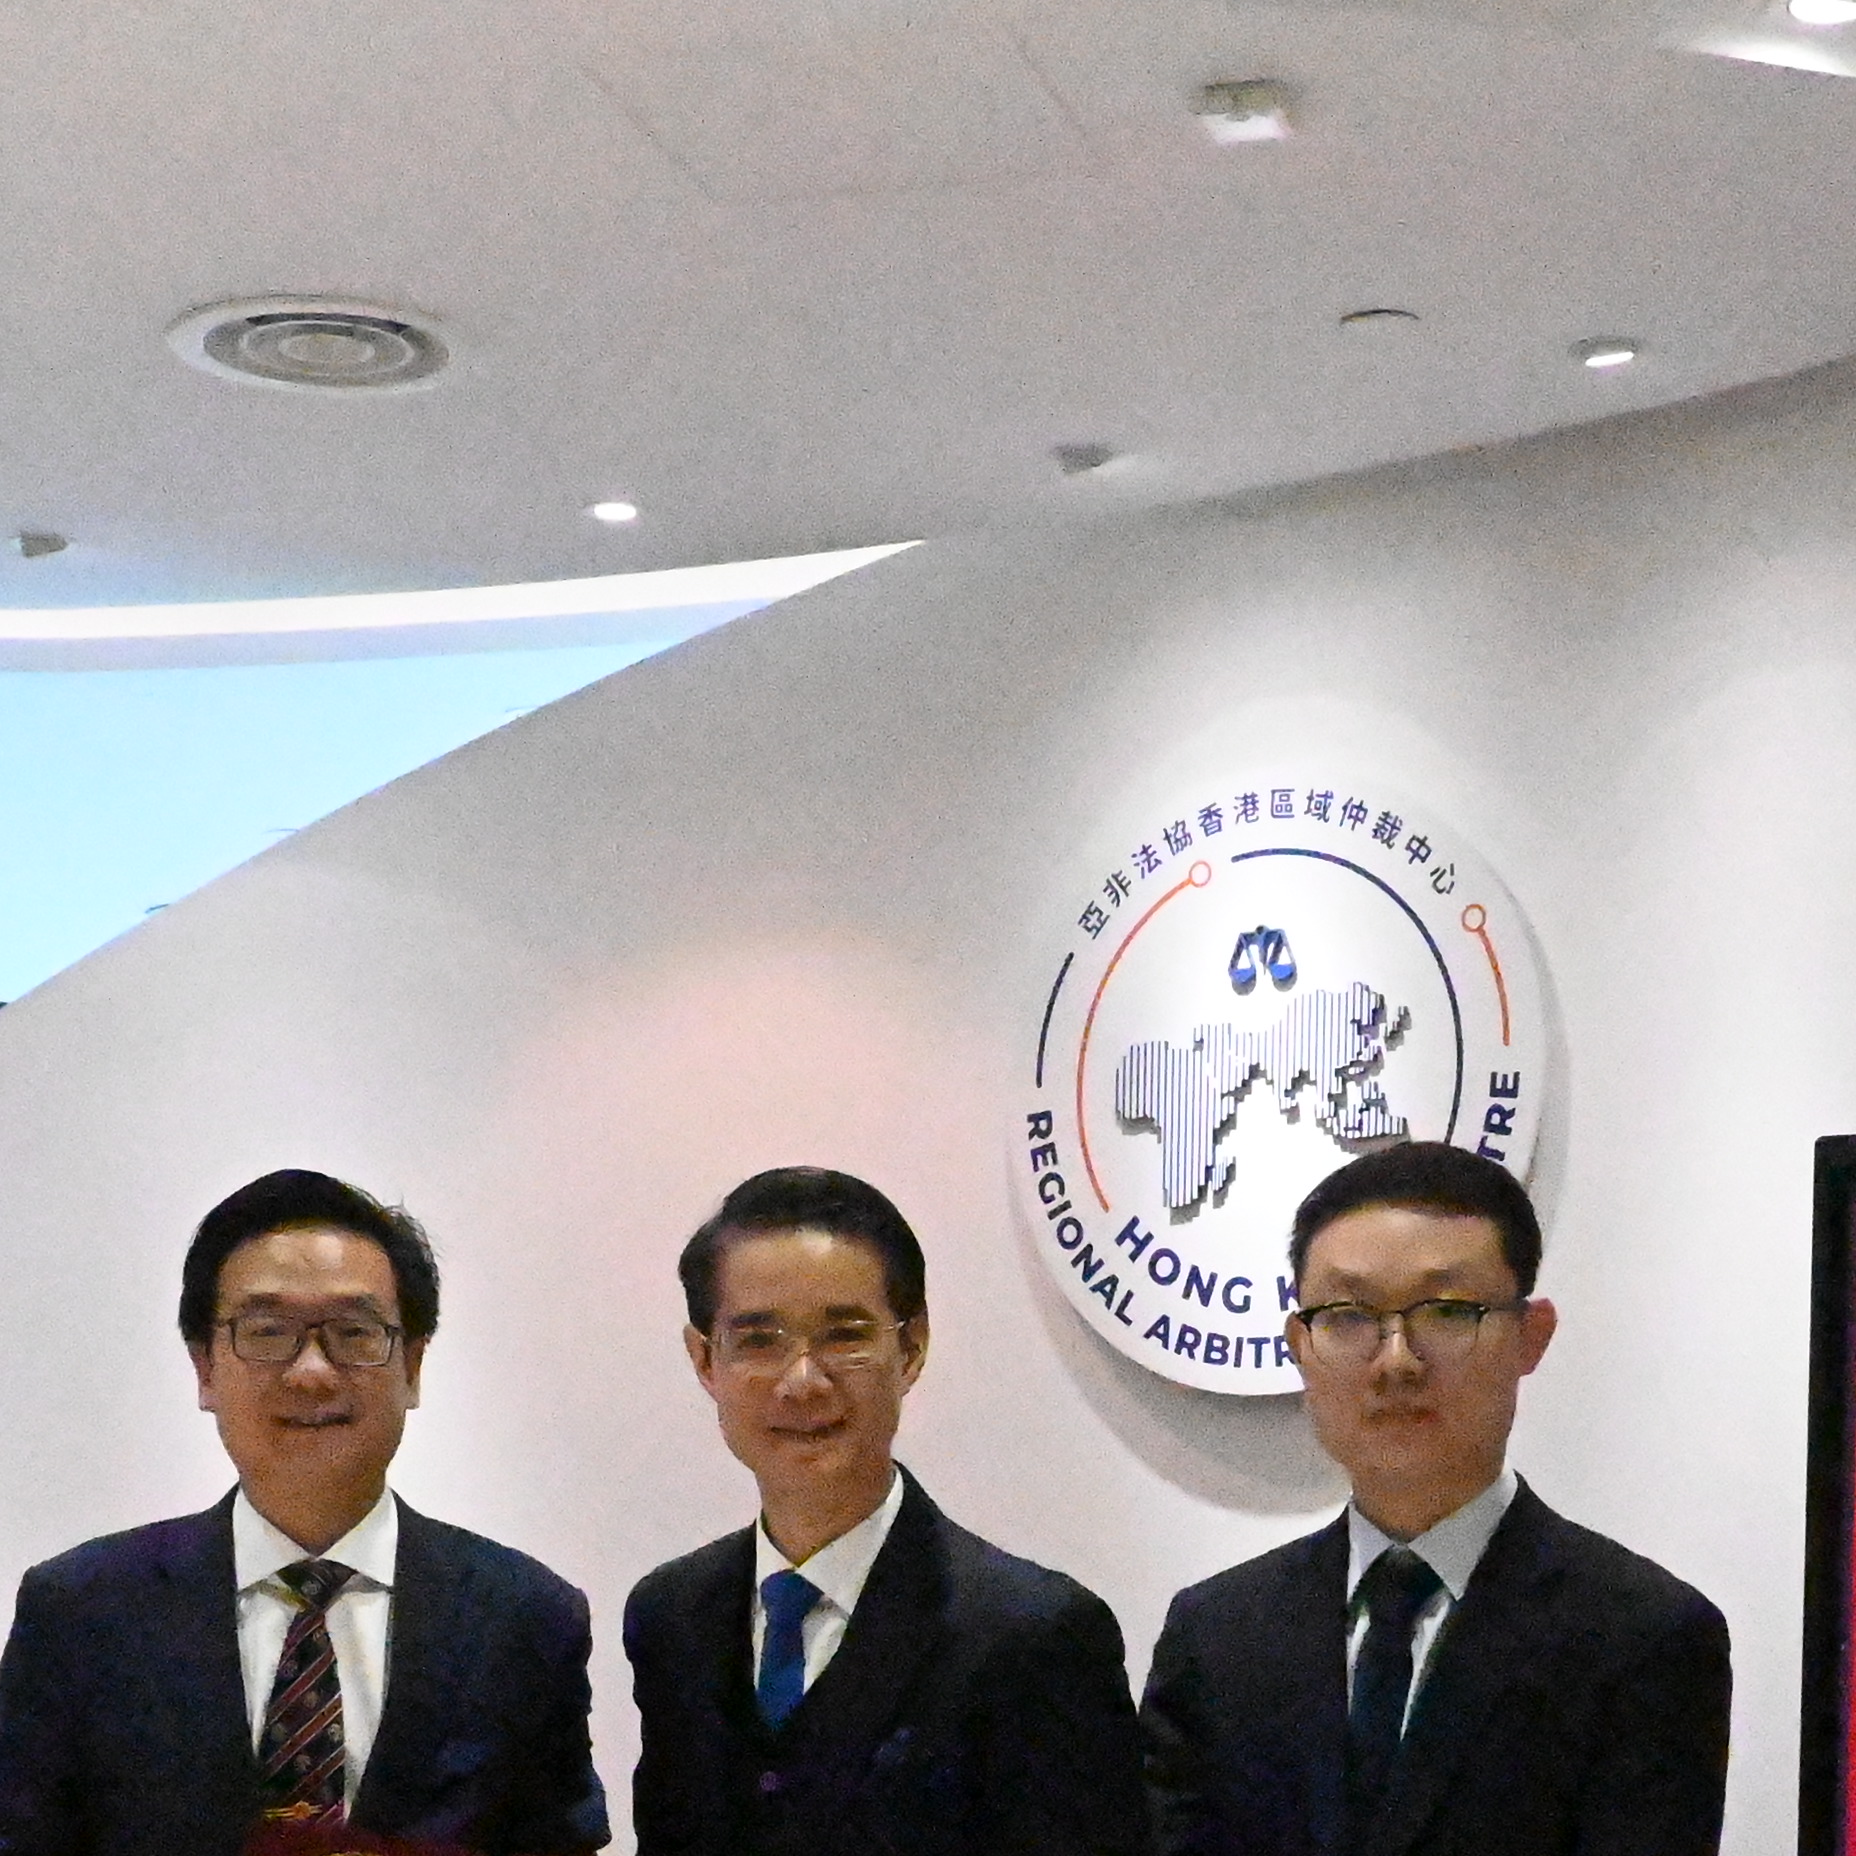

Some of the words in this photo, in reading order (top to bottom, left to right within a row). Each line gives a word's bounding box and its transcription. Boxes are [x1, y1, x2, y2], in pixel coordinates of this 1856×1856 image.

[1078, 788, 1456, 940] 亞非法協香港區域仲裁中心
[1026, 1110, 1133, 1326] REGIONAL
[1144, 1315, 1296, 1369] ARBITR
[1476, 1071, 1520, 1161] TRE
[1114, 1216, 1253, 1314] HONG
